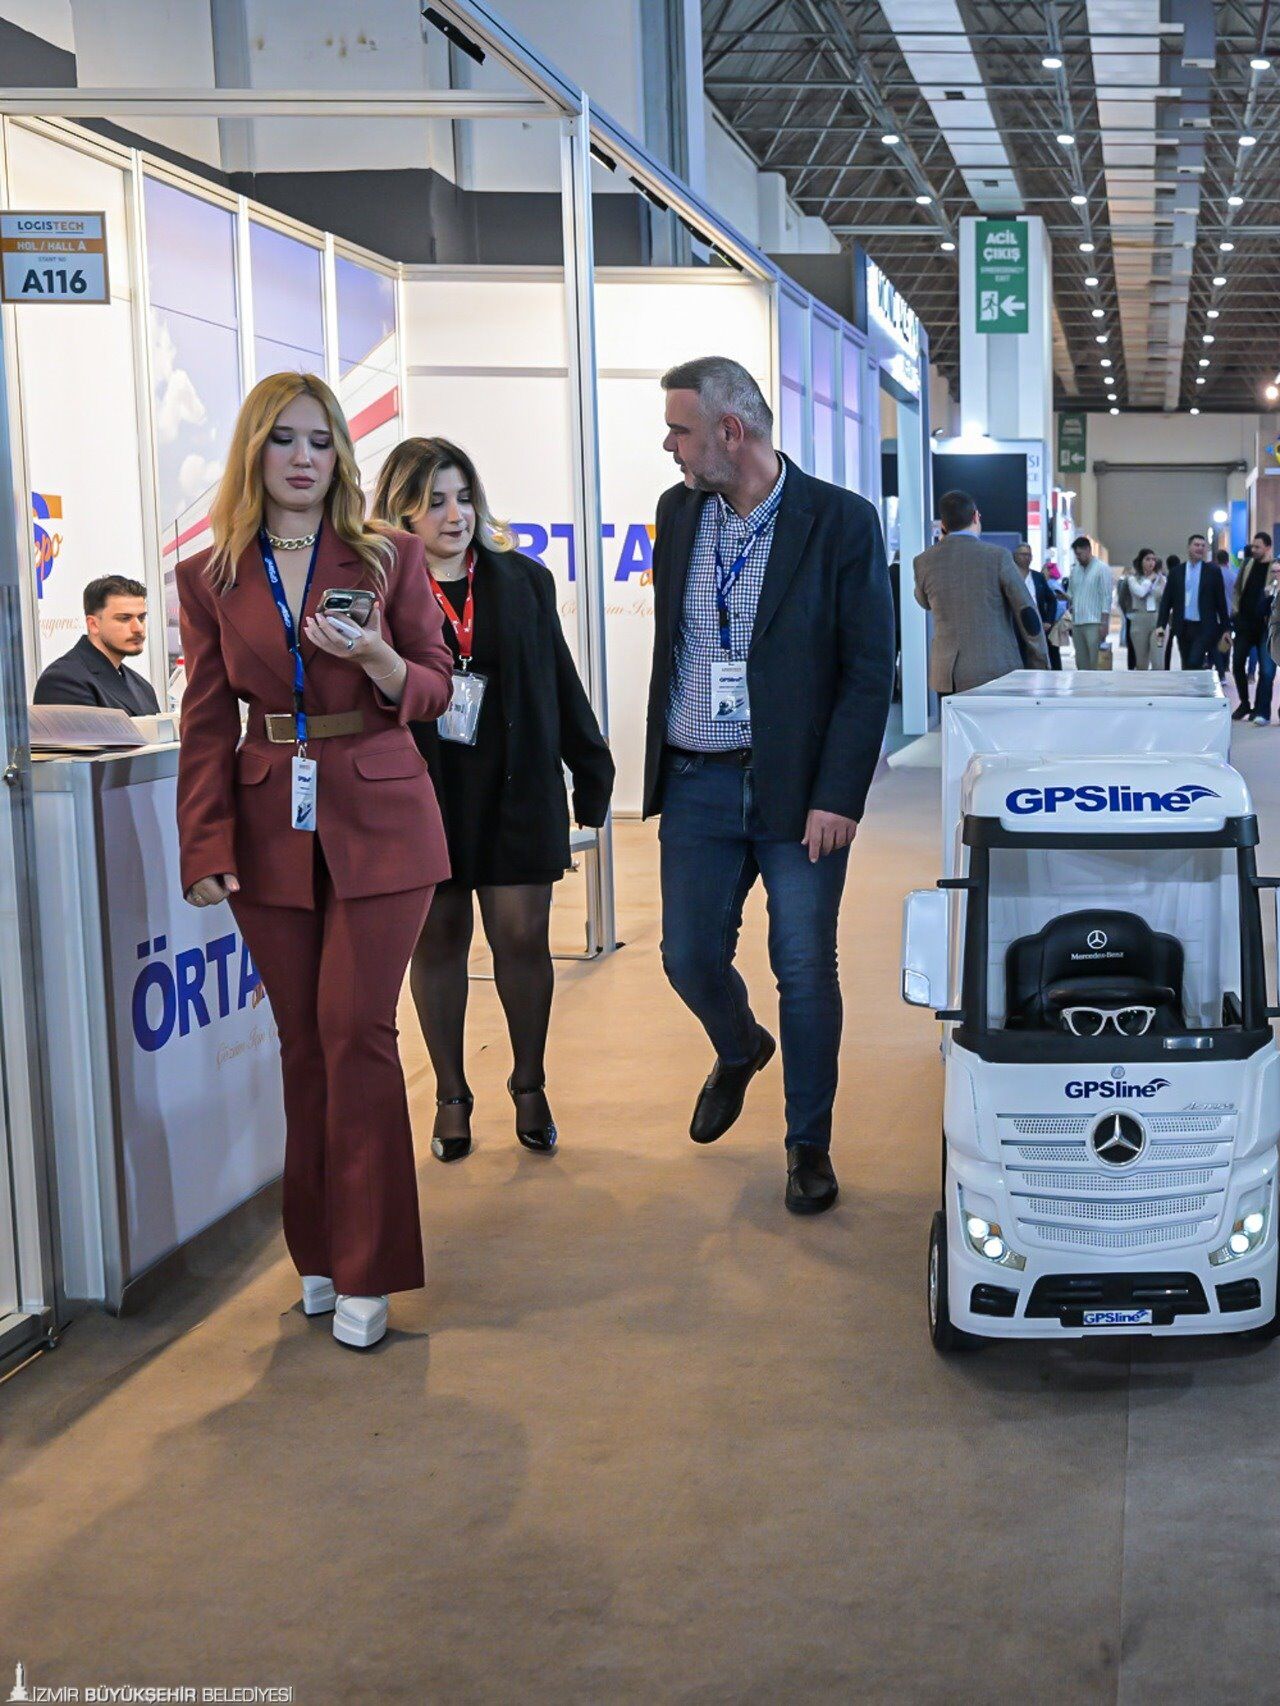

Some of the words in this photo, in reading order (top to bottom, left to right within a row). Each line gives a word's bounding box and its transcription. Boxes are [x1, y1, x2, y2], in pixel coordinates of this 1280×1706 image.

[17, 221, 84, 231] LOGISTECH
[985, 229, 1018, 245] ACİL
[48, 242, 74, 251] HALL
[77, 240, 87, 251] A
[983, 247, 1021, 262] ÇIKIŞ
[21, 269, 88, 294] A116
[1005, 785, 1191, 815] GPSline
[1071, 951, 1125, 960] Mercedes-Benz
[1064, 1080, 1157, 1099] GPSline
[1084, 1312, 1140, 1323] GPSline
